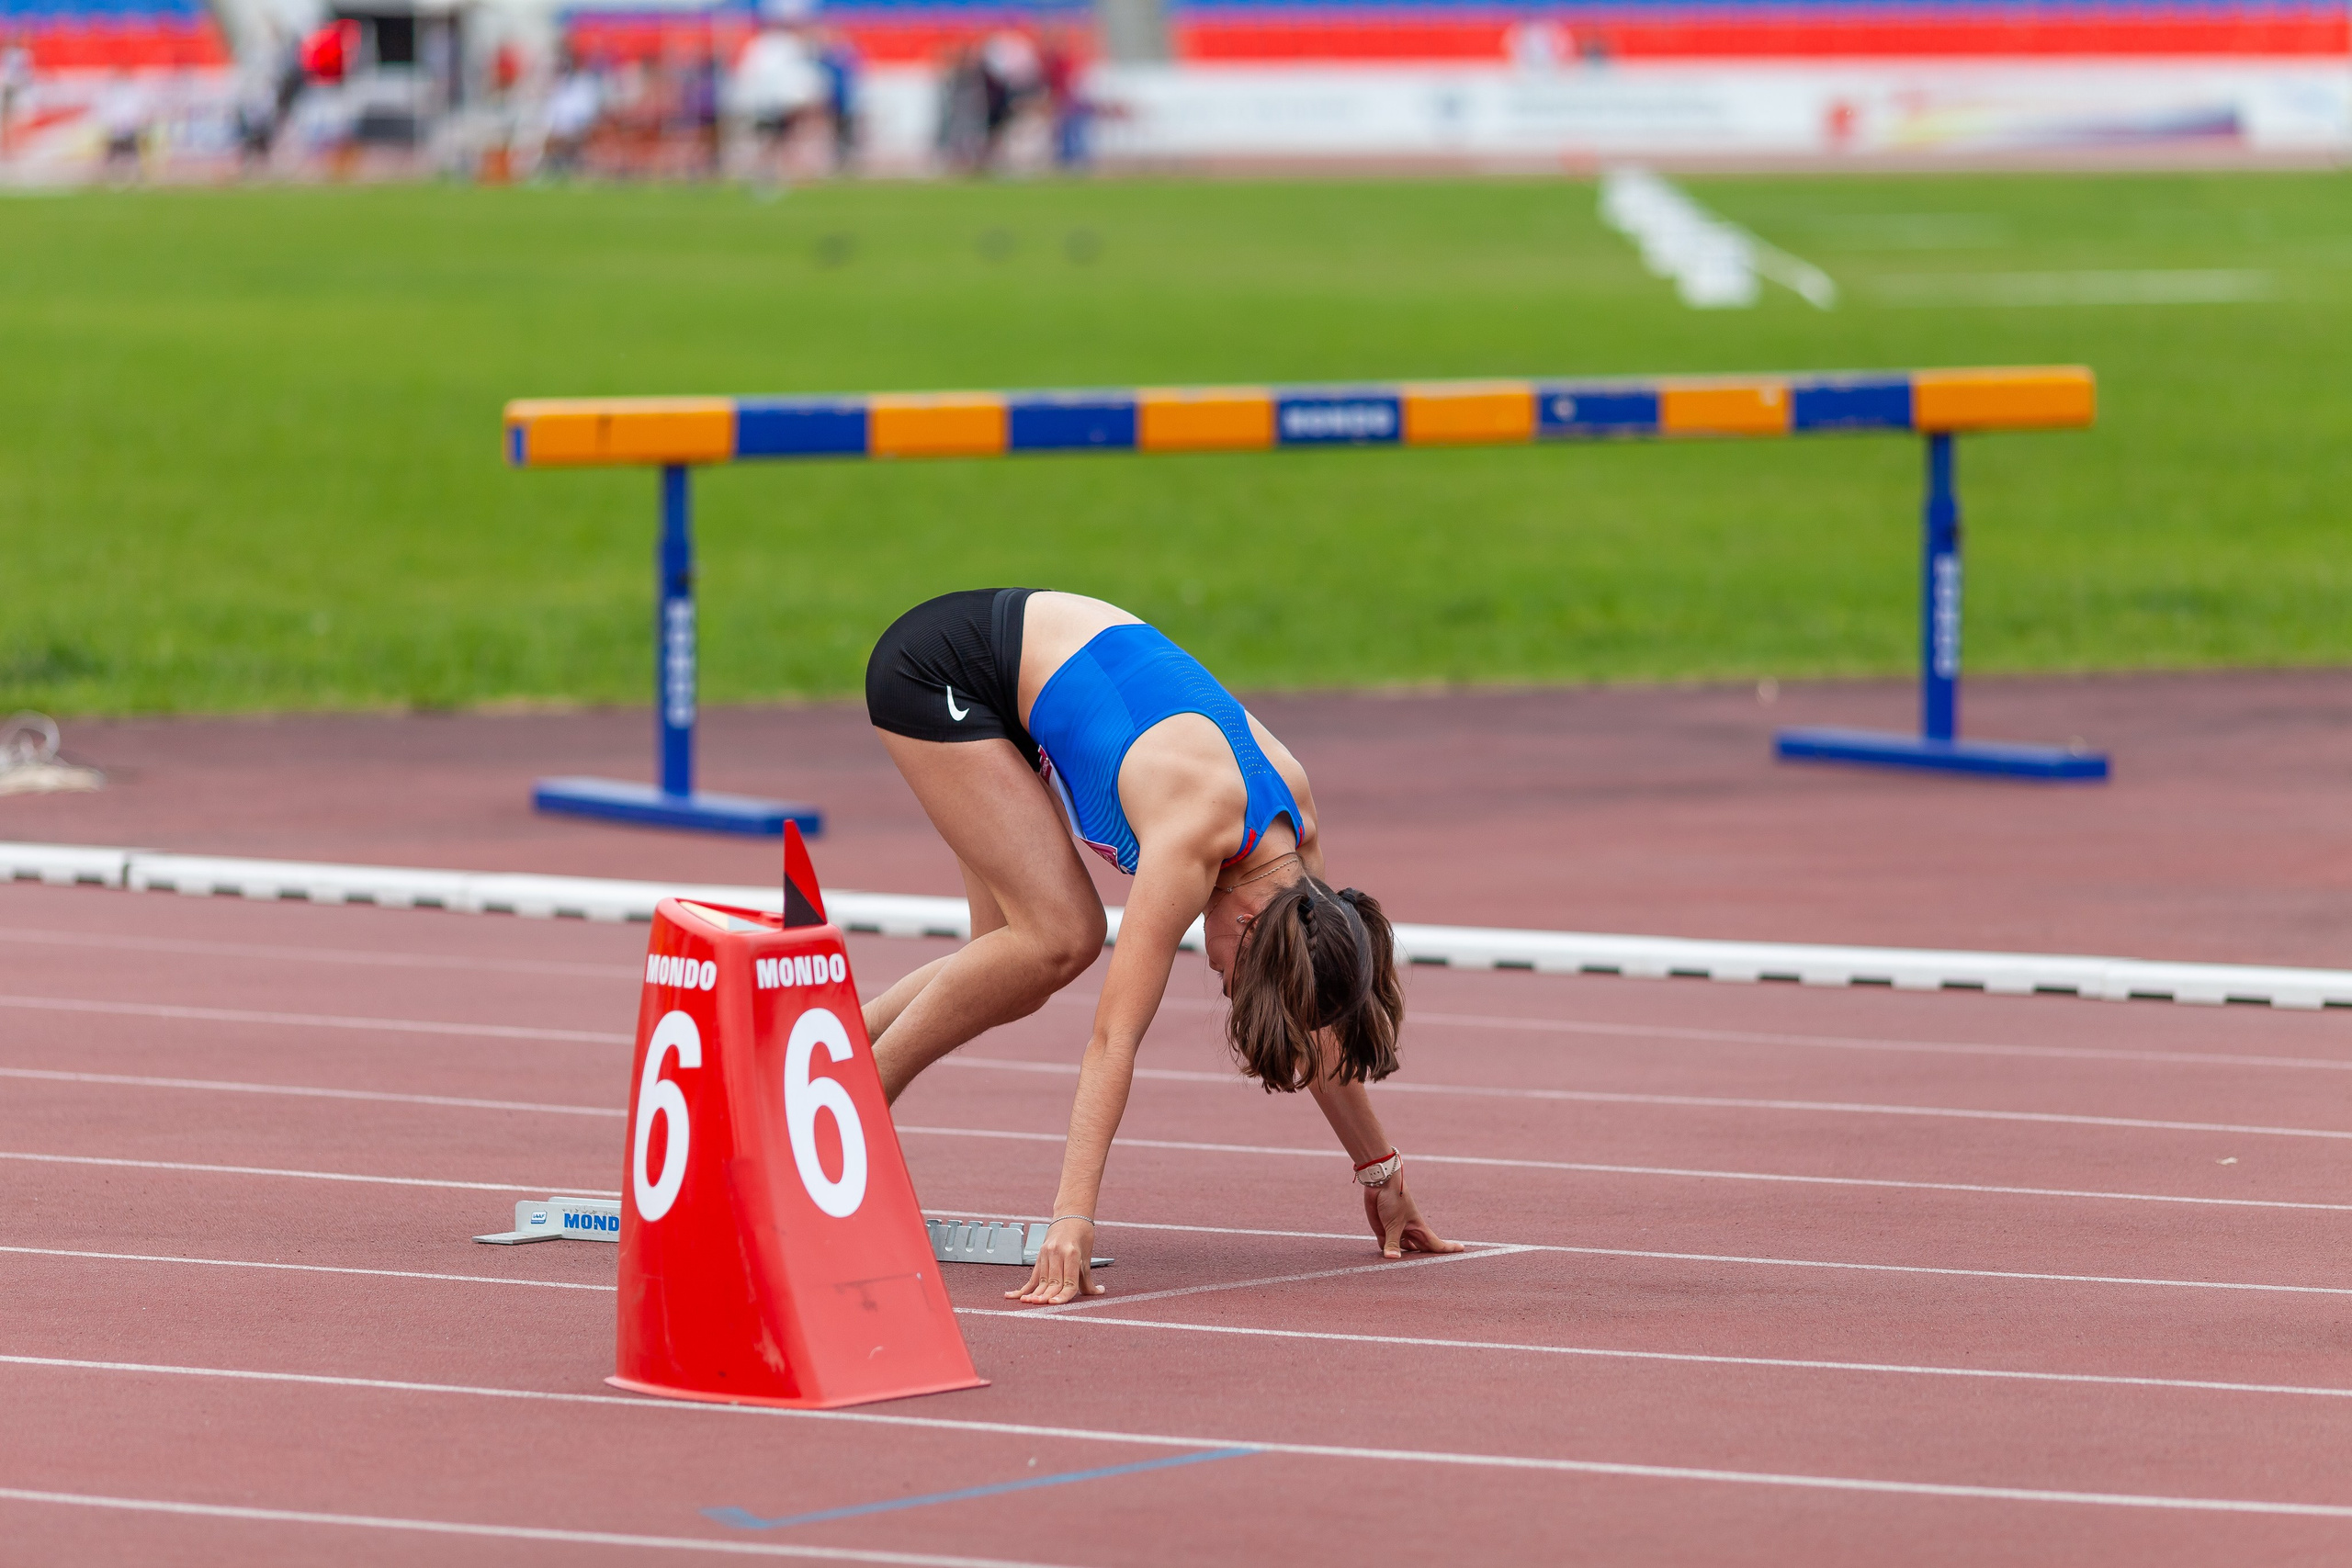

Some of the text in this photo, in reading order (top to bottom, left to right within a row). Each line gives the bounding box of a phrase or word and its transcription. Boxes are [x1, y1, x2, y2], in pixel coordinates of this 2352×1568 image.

[646, 953, 717, 991] MONDO
[756, 953, 846, 989] MONDO
[632, 1010, 702, 1223] 6
[784, 1008, 868, 1219] 6
[564, 1213, 619, 1232] MOND
